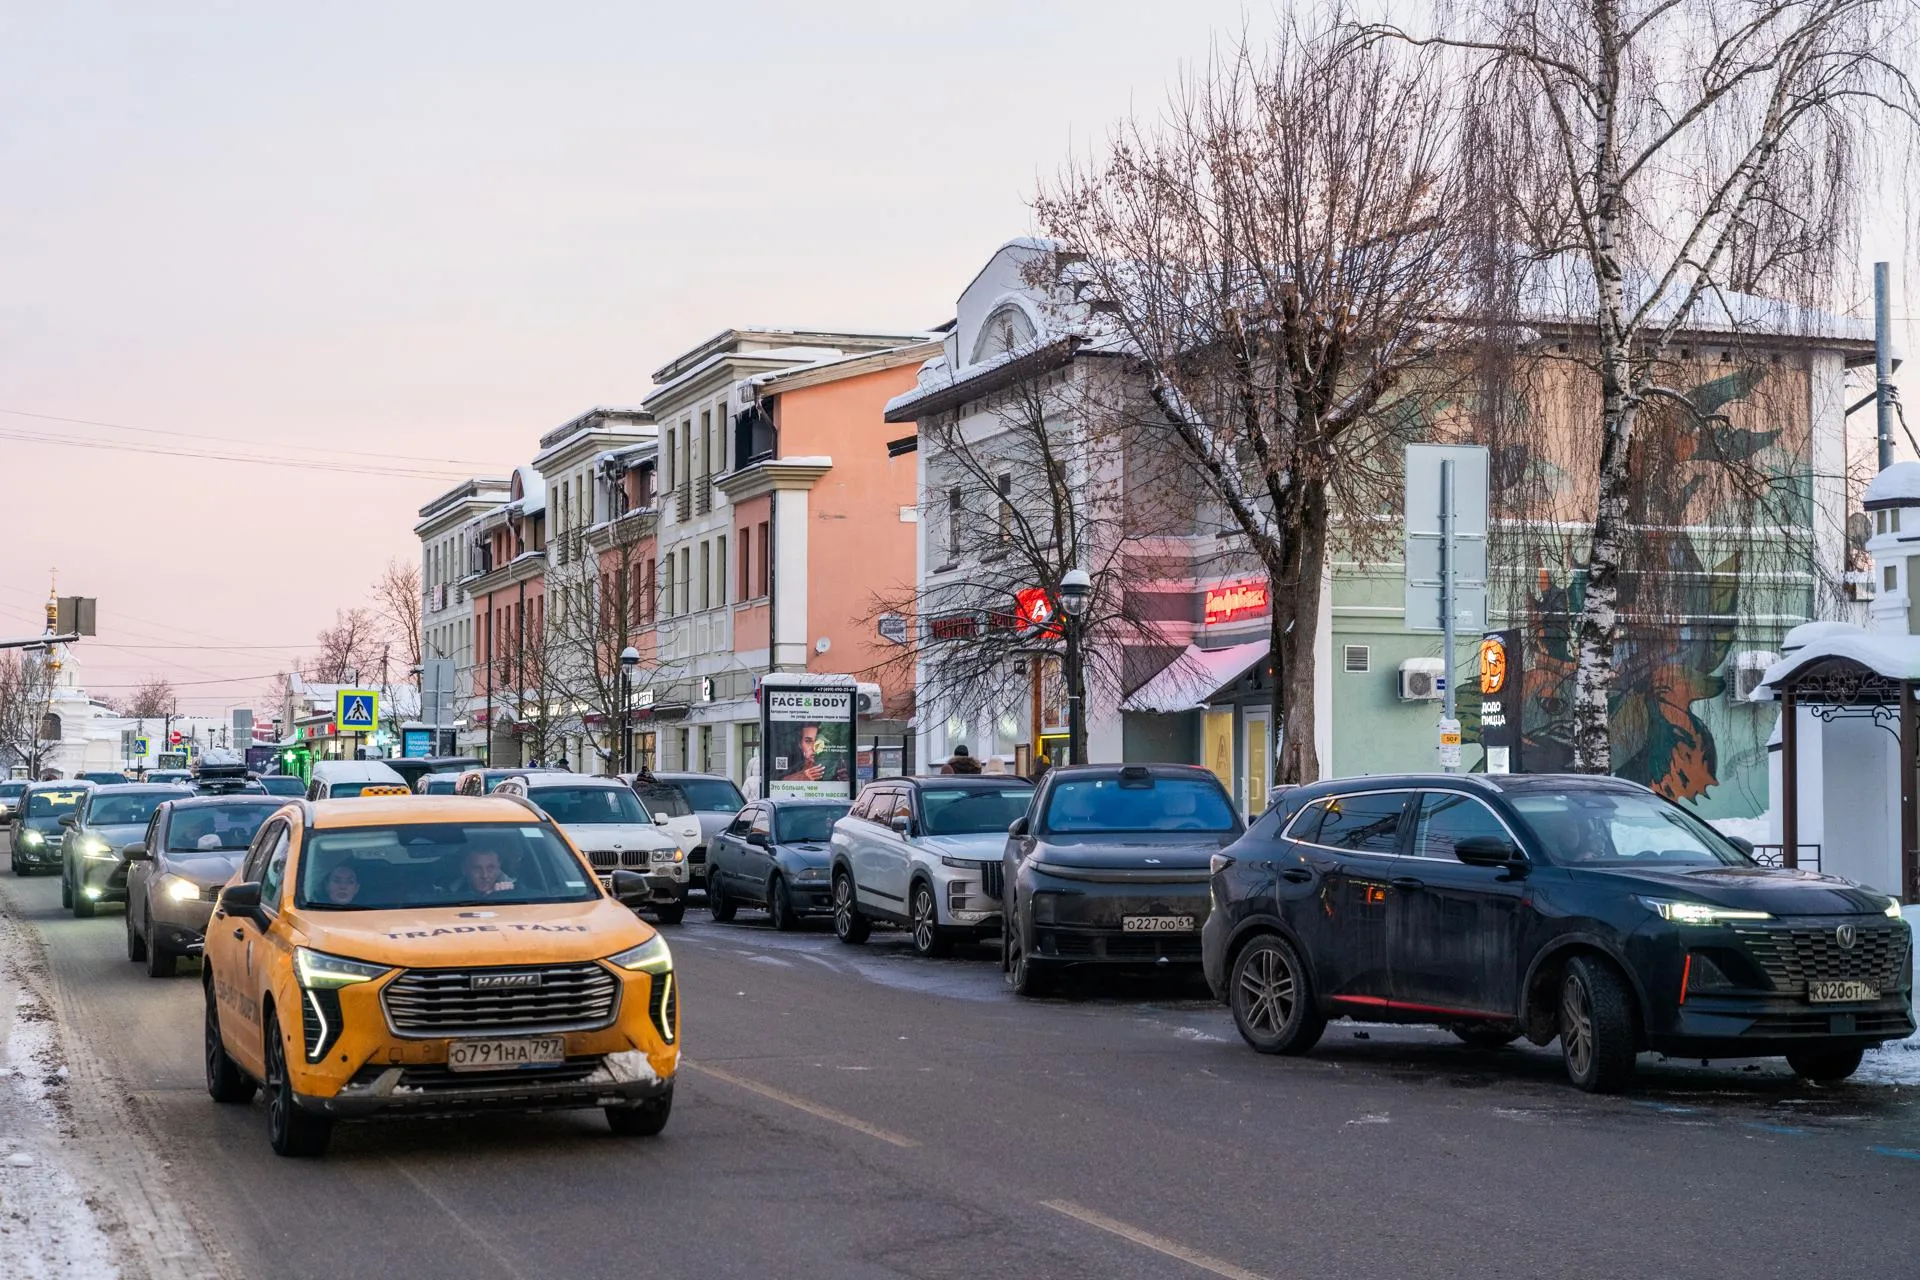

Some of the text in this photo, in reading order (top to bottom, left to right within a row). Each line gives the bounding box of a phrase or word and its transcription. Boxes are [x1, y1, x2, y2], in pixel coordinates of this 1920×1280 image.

[771, 697, 848, 707] FACE&BODY
[1481, 701, 1501, 714] ДОДО
[1481, 714, 1506, 726] ПИЦЦА
[381, 924, 589, 940] TRADE TAXI
[476, 975, 538, 987] HAVAL
[531, 1040, 559, 1055] 797
